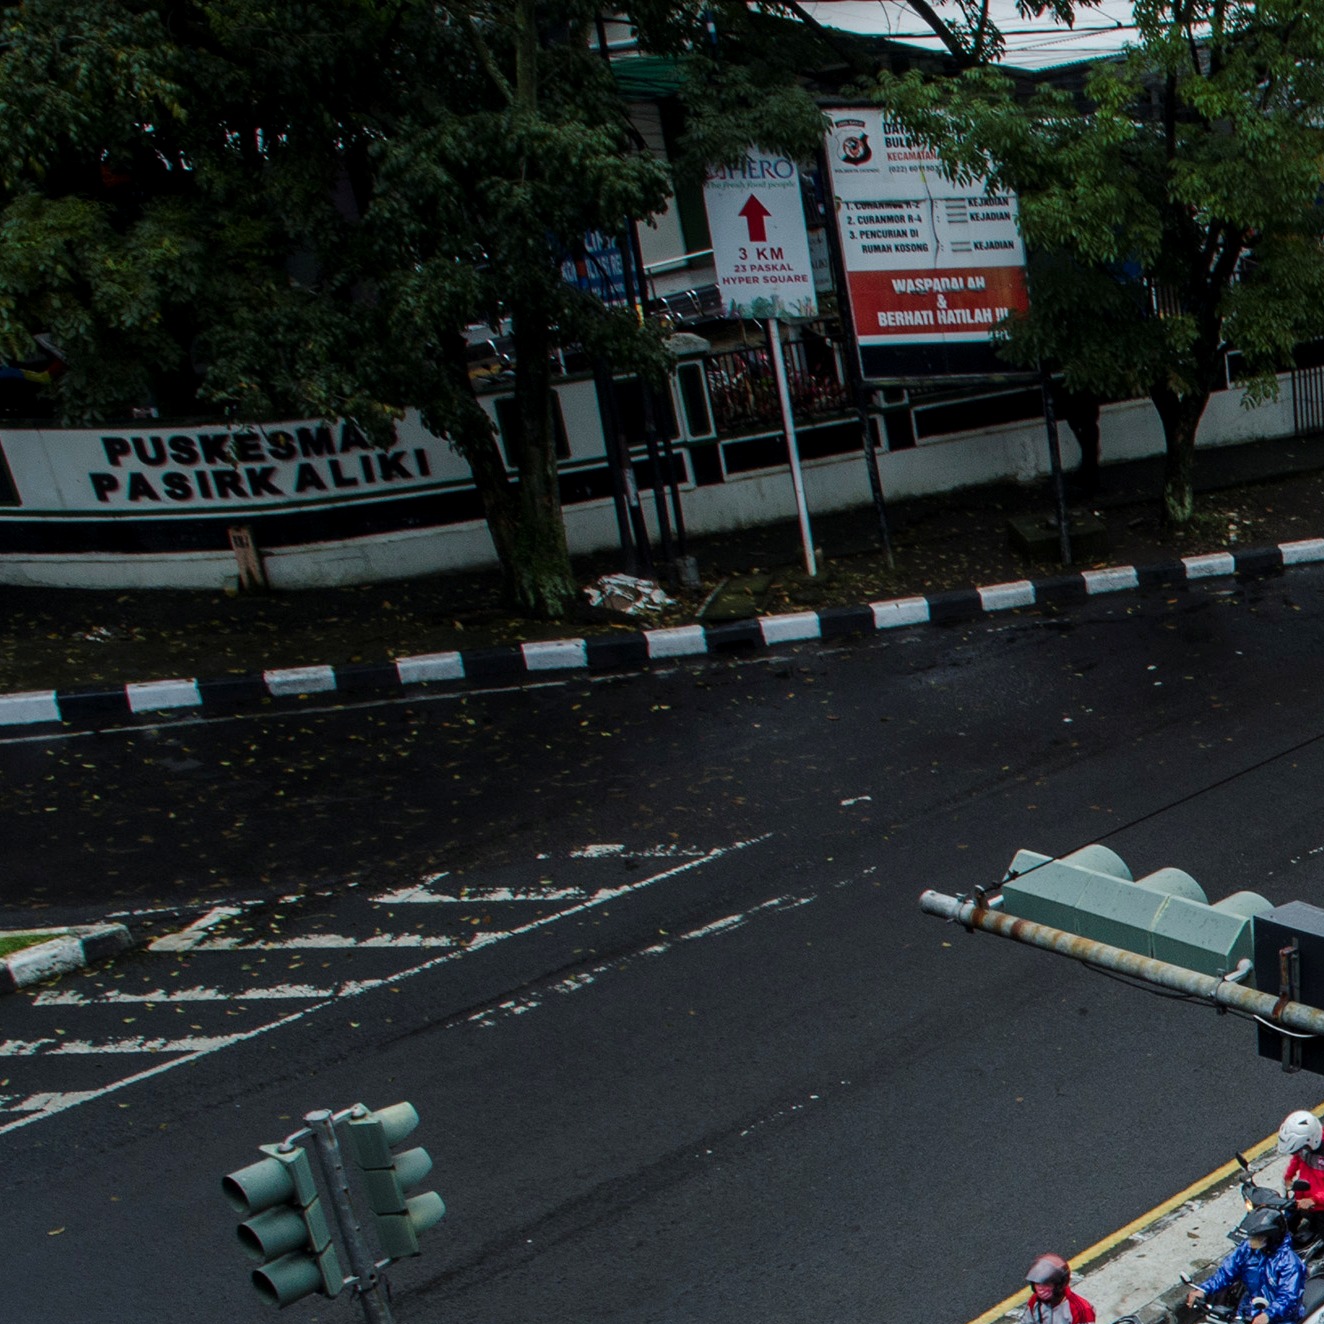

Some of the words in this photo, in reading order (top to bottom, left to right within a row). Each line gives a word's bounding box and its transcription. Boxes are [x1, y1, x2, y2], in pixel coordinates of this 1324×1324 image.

[726, 159, 794, 179] HERO
[968, 197, 1009, 208] KEJADIAN
[847, 216, 856, 225] 2.
[857, 215, 906, 224] CURANMOR
[969, 212, 1011, 222] KEJADIAN
[849, 231, 858, 239] 3.
[860, 229, 909, 239] PENCURIAN
[910, 229, 919, 238] DI
[862, 244, 893, 254] RUMAH
[895, 243, 929, 253] KOSONG
[973, 240, 1015, 250] KEJADIAN
[738, 248, 748, 260] 3
[757, 247, 784, 260] KM
[734, 265, 747, 273] 23
[750, 263, 794, 272] PASKAL
[722, 276, 760, 285] HYPER
[763, 274, 809, 284] SQUARE
[937, 295, 948, 309] &
[877, 310, 935, 328] BERHATI
[937, 308, 993, 325] HATILAH
[101, 423, 397, 467] PUSKESMA
